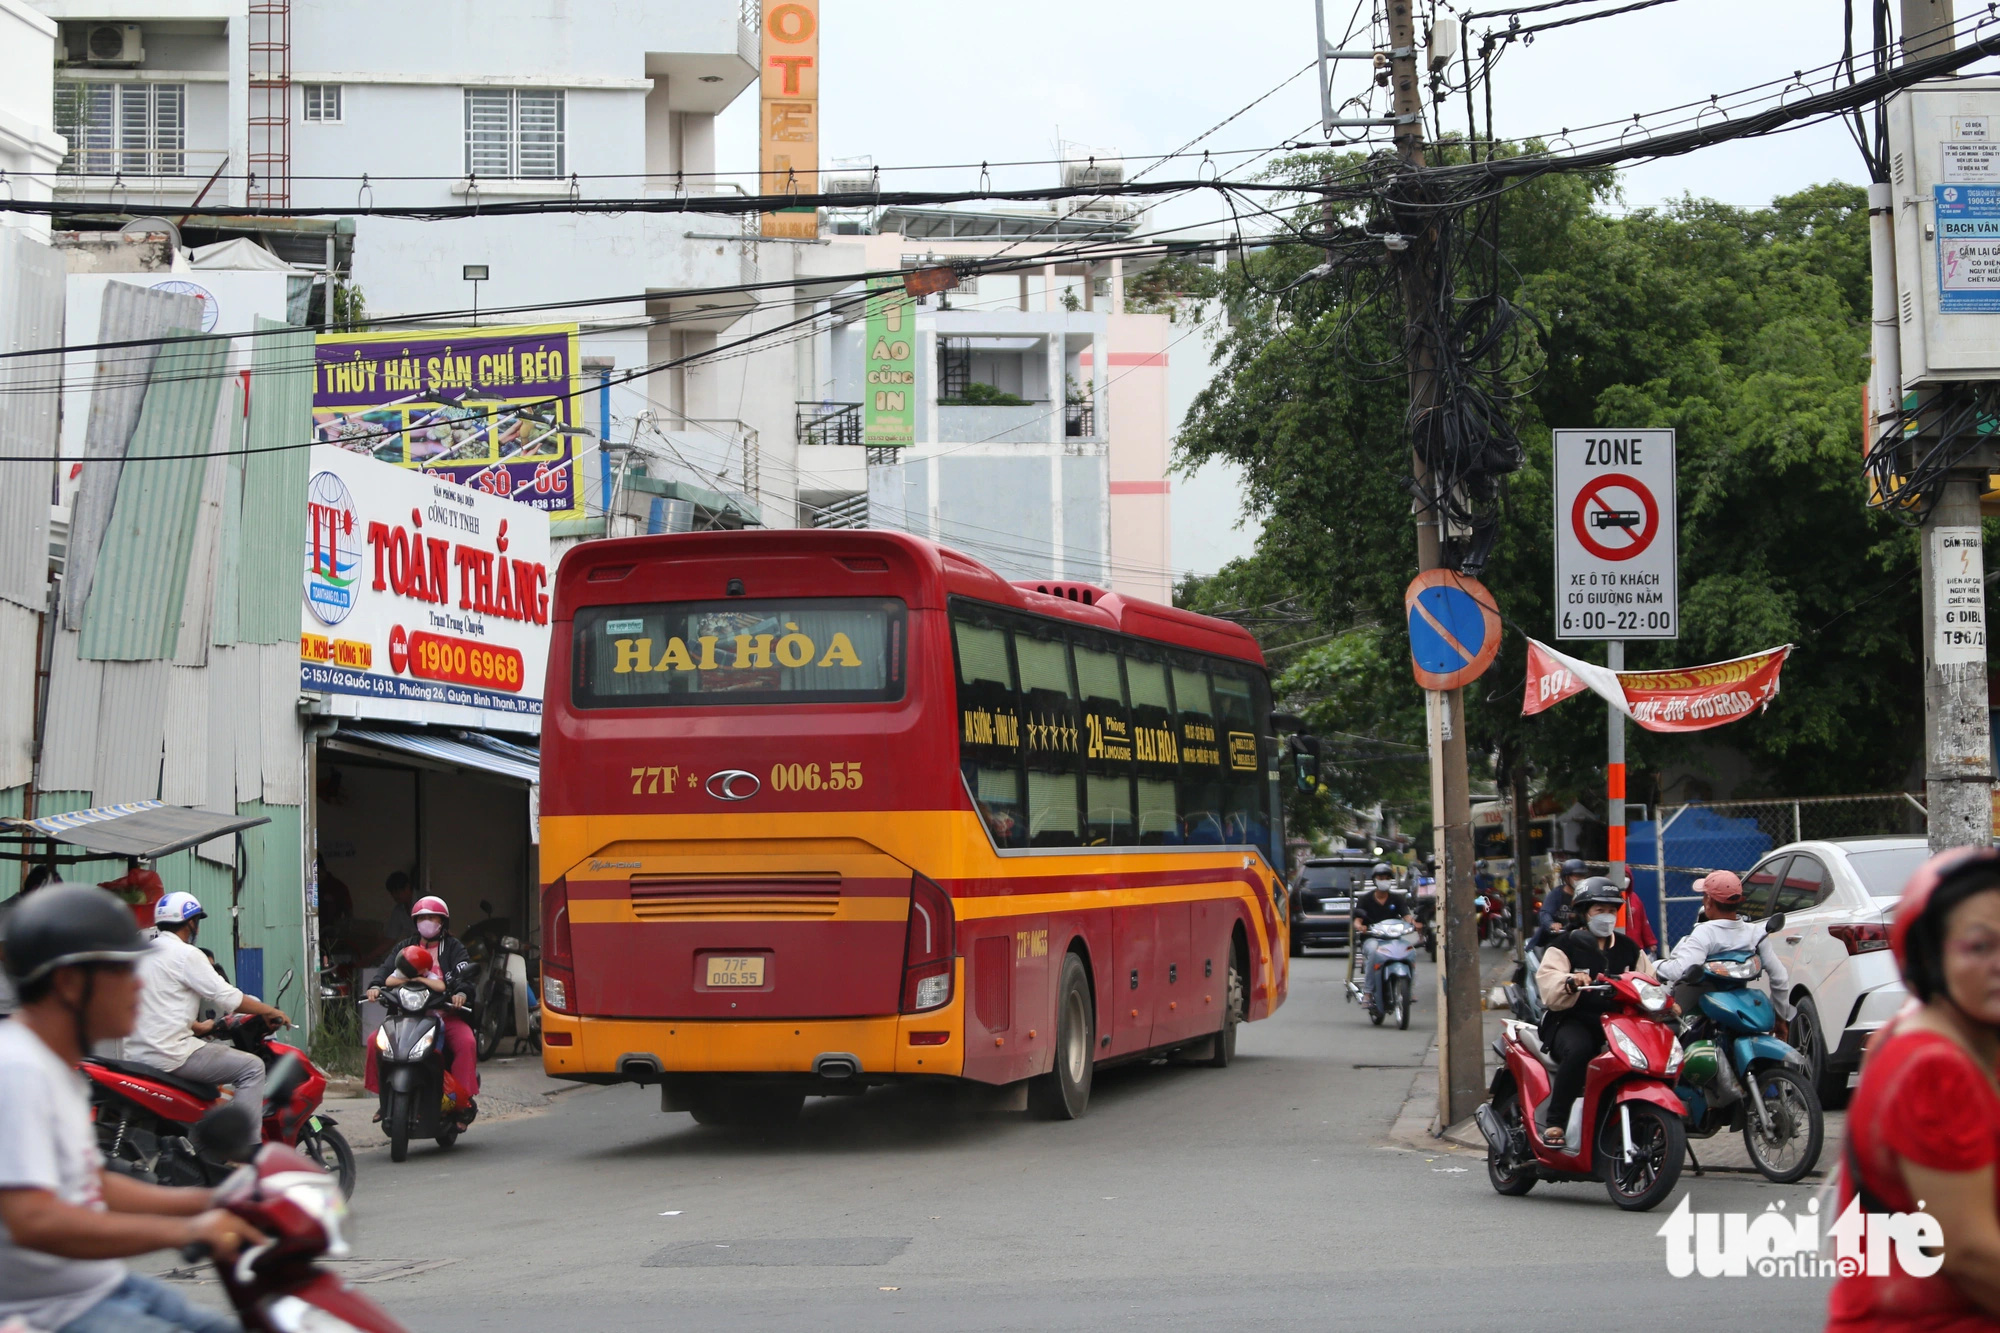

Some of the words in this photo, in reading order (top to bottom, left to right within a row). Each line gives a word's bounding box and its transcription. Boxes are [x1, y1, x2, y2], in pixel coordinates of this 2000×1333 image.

[1946, 223, 1974, 234] BẠCH
[1977, 221, 1998, 232] VÂN
[871, 336, 910, 361] ÁO
[324, 350, 377, 393] THỦY
[384, 348, 421, 391] HẢI
[427, 346, 472, 388] SẢN
[478, 347, 515, 386] CHÍ
[521, 344, 563, 384] BÉO
[867, 364, 914, 384] CŨNG
[875, 390, 905, 411] IN
[1585, 438, 1643, 465] ZONE
[534, 460, 567, 493] ỐC
[428, 499, 449, 525] CÔNG
[450, 510, 459, 530] TY
[460, 513, 480, 535] TNHH
[367, 507, 449, 606] TOÀN
[455, 518, 549, 626] THẮNG
[1571, 573, 1586, 585] XE
[1590, 571, 1597, 585] Ô
[1601, 571, 1616, 585] TÔ
[1620, 570, 1660, 586] KHÁCH
[1568, 589, 1583, 604] CÓ
[1587, 588, 1633, 604] GIƯỜNG
[1637, 586, 1663, 604] NẰM
[418, 640, 466, 675] 1900
[470, 650, 518, 683] 6968
[613, 636, 719, 673] HAI
[732, 622, 862, 668] HÒA
[344, 672, 371, 690] Quốc
[399, 682, 431, 699] Phường
[447, 690, 472, 706] Quận
[473, 692, 491, 707] Bình
[1713, 690, 1755, 715] GRAB
[964, 710, 974, 743] AN
[1086, 713, 1104, 758] 24
[1105, 716, 1126, 735] Phòng
[1104, 744, 1131, 760] LIMOUSINE
[1134, 726, 1157, 762] HAI
[1157, 720, 1179, 763] HÒA
[631, 766, 679, 795] 77F
[771, 762, 864, 792] 006.55
[713, 972, 757, 985] 006.55
[724, 959, 748, 971] 77F
